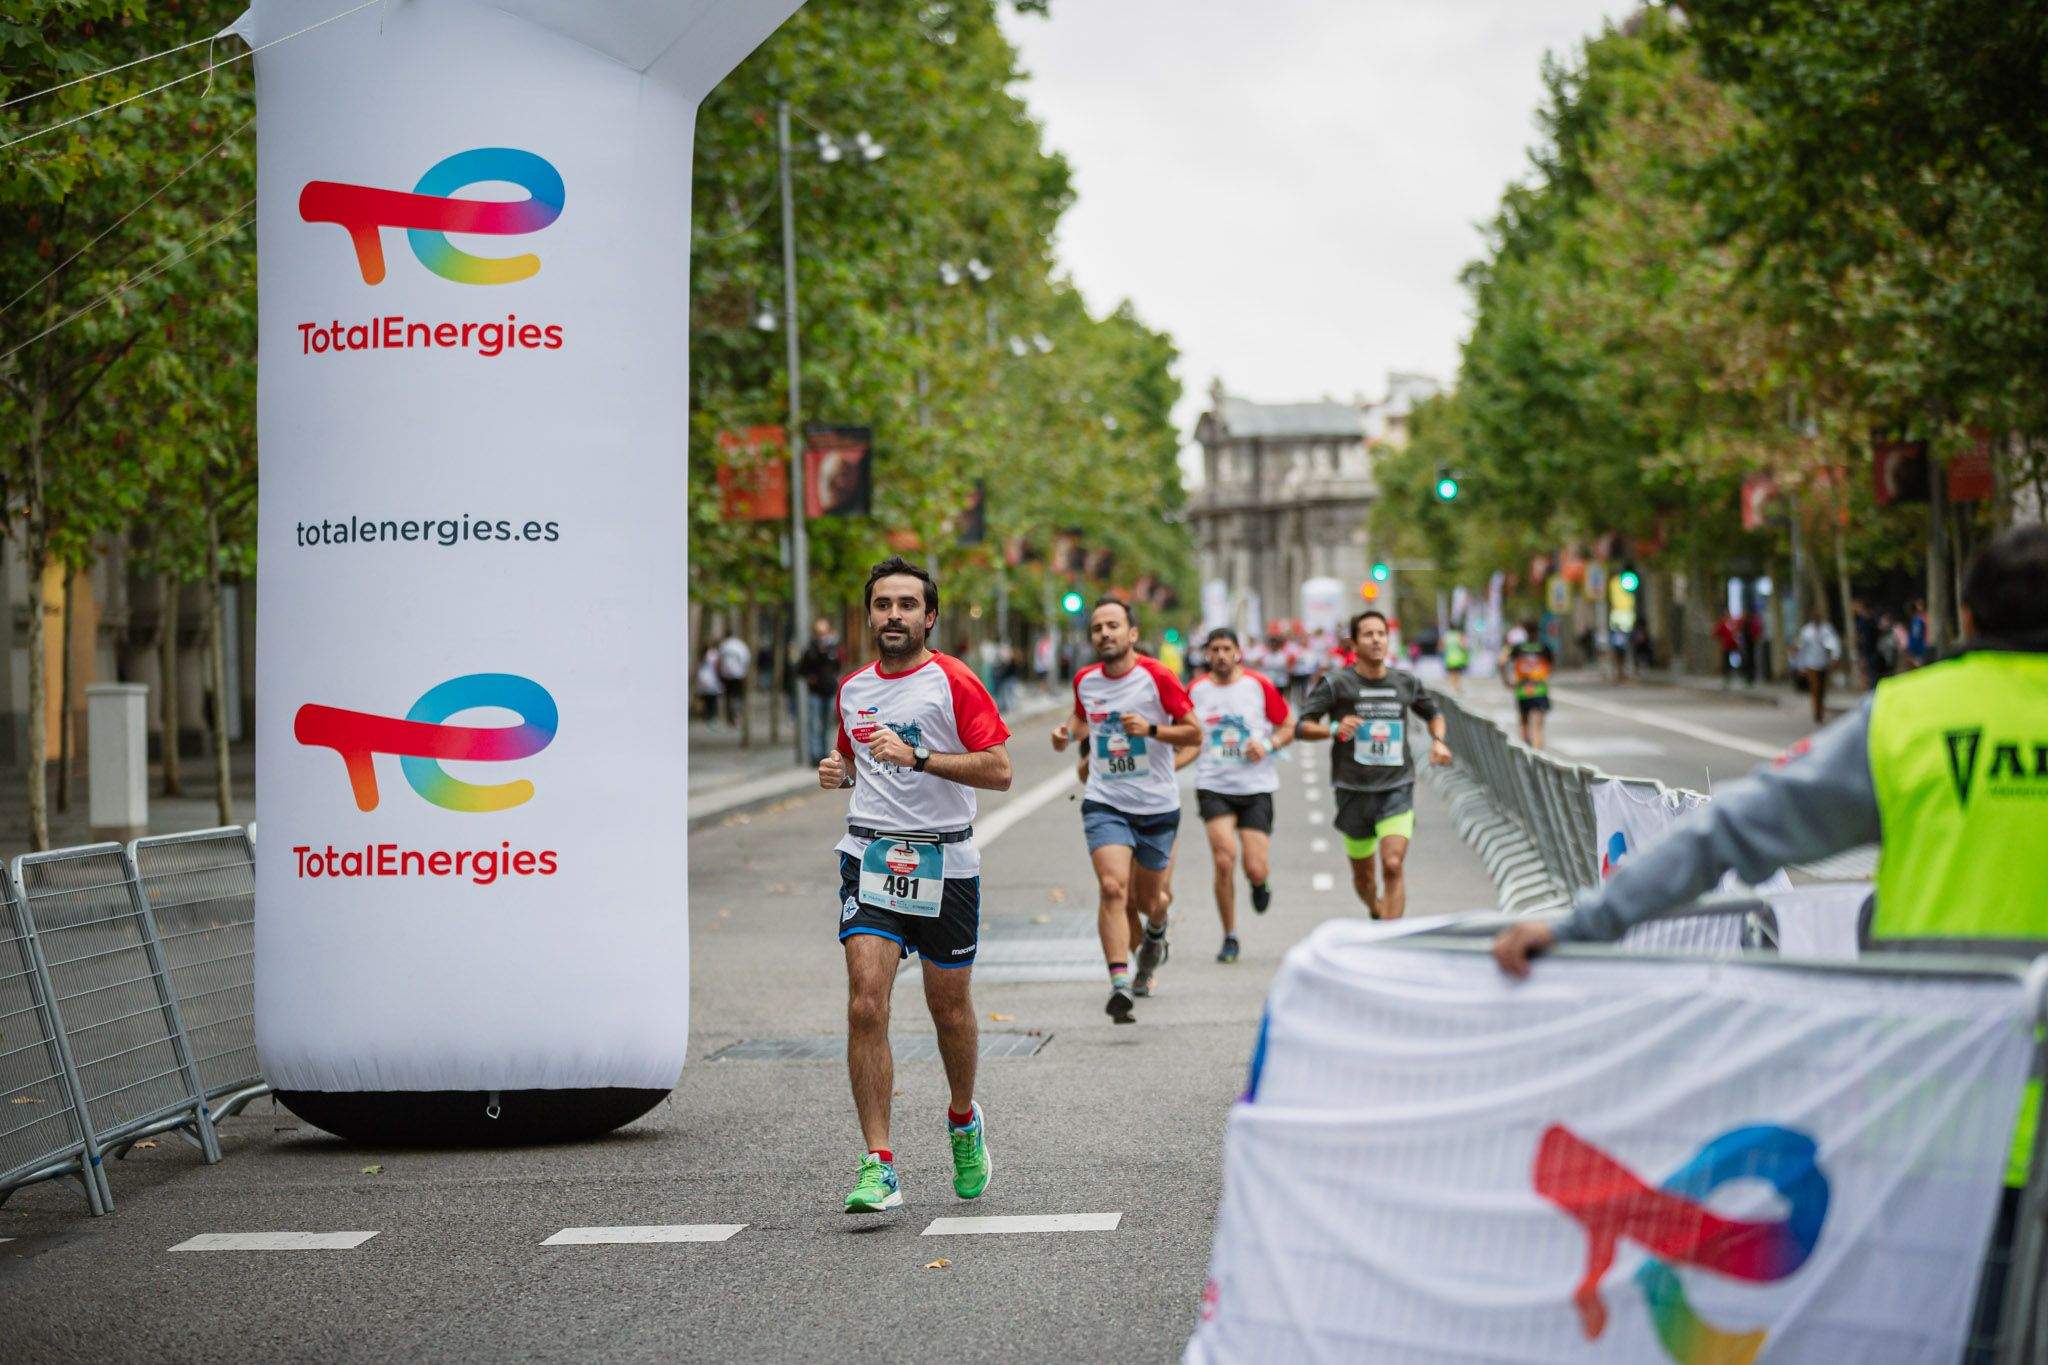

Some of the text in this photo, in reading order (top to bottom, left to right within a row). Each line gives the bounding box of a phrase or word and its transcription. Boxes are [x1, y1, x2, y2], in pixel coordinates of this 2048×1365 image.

[299, 313, 564, 358] TotalEnergies
[296, 513, 560, 548] totalenergies.es
[1108, 756, 1136, 774] 508
[292, 840, 558, 886] TotalEnergies
[882, 874, 921, 900] 491
